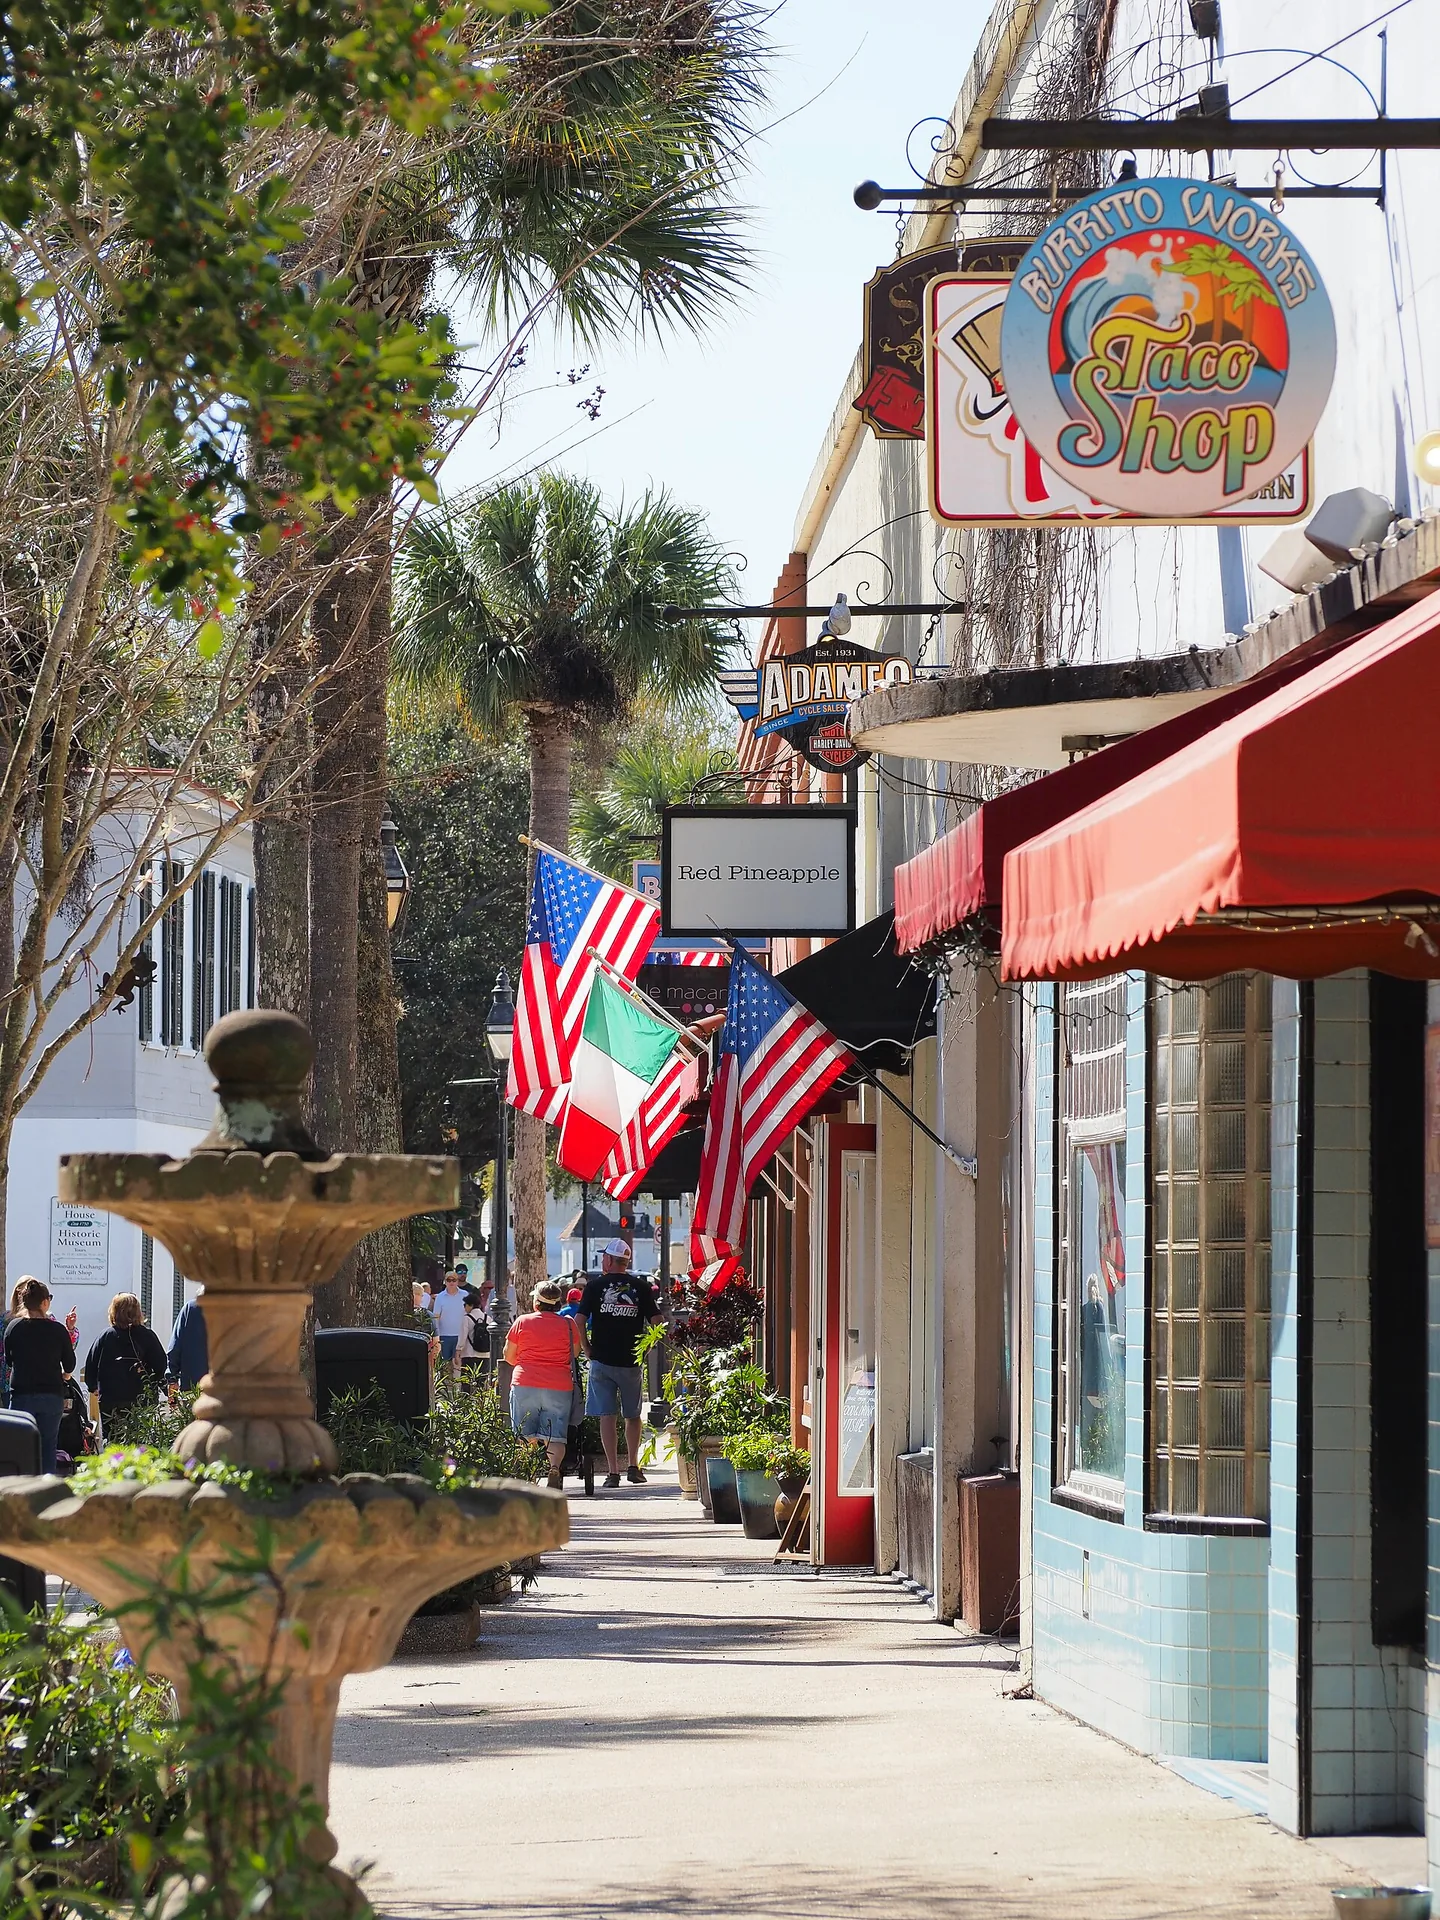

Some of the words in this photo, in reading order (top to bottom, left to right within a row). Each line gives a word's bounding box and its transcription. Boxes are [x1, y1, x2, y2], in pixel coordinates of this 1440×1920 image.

[1020, 186, 1163, 314] BURRITO
[1180, 187, 1317, 310] WORKS
[1091, 313, 1255, 391] Taco
[1058, 357, 1275, 496] Shop
[798, 706, 821, 716] CYCLE
[822, 703, 845, 714] SALES
[763, 719, 790, 732] SINCE
[677, 865, 722, 880] Red
[728, 865, 840, 884] Pineapple
[666, 987, 728, 1000] macar
[65, 1210, 96, 1219] House
[59, 1229, 101, 1238] Historic
[57, 1238, 102, 1247] Museum
[79, 1263, 105, 1271] Exchange
[600, 1303, 615, 1313] SIG
